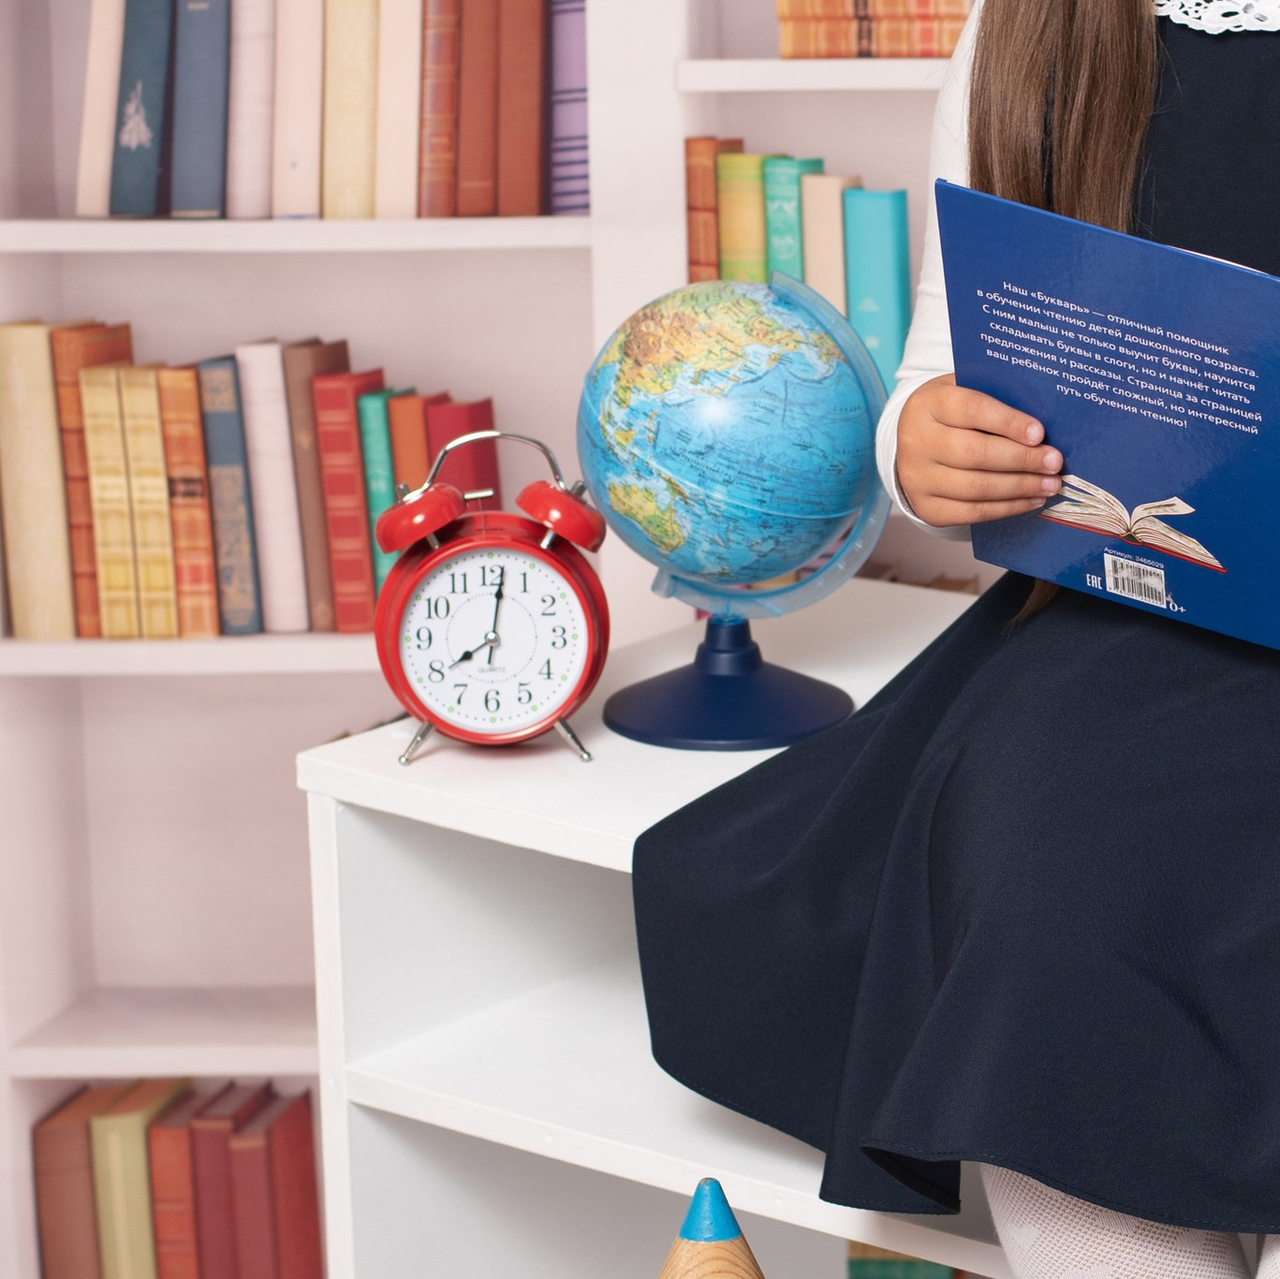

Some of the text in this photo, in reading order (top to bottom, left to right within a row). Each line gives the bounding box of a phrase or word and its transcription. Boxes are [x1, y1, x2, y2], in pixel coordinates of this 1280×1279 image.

[1003, 282, 1028, 296] Наш
[1030, 292, 1089, 314] «Букварь»
[1106, 314, 1164, 336] отличный
[1166, 331, 1230, 355] помощник
[976, 289, 1259, 378] в обучении чтению детей дошкольного возраста.
[982, 304, 1256, 392] С ним малыш не только выучит буквы, научится
[990, 322, 1250, 404] складывать буквы в слоги, но и начнёт читать
[980, 333, 1262, 422] предложения и рассказы. Страница за страницей
[986, 349, 1258, 435] ваш ребёнок пройдёт сложный, но интересный
[1056, 384, 1187, 428] путь обучения чтению!
[450, 572, 470, 594] 11
[479, 564, 505, 586] 12
[520, 572, 530, 593] 1
[425, 596, 450, 619] 10
[541, 594, 556, 616] 2
[1170, 602, 1186, 612] 0+
[416, 627, 432, 650] 9
[552, 626, 567, 649] 3
[428, 660, 445, 683] 8
[538, 658, 554, 680] 4
[454, 684, 468, 705] 7
[484, 689, 500, 712] 6
[518, 682, 532, 704] 5
